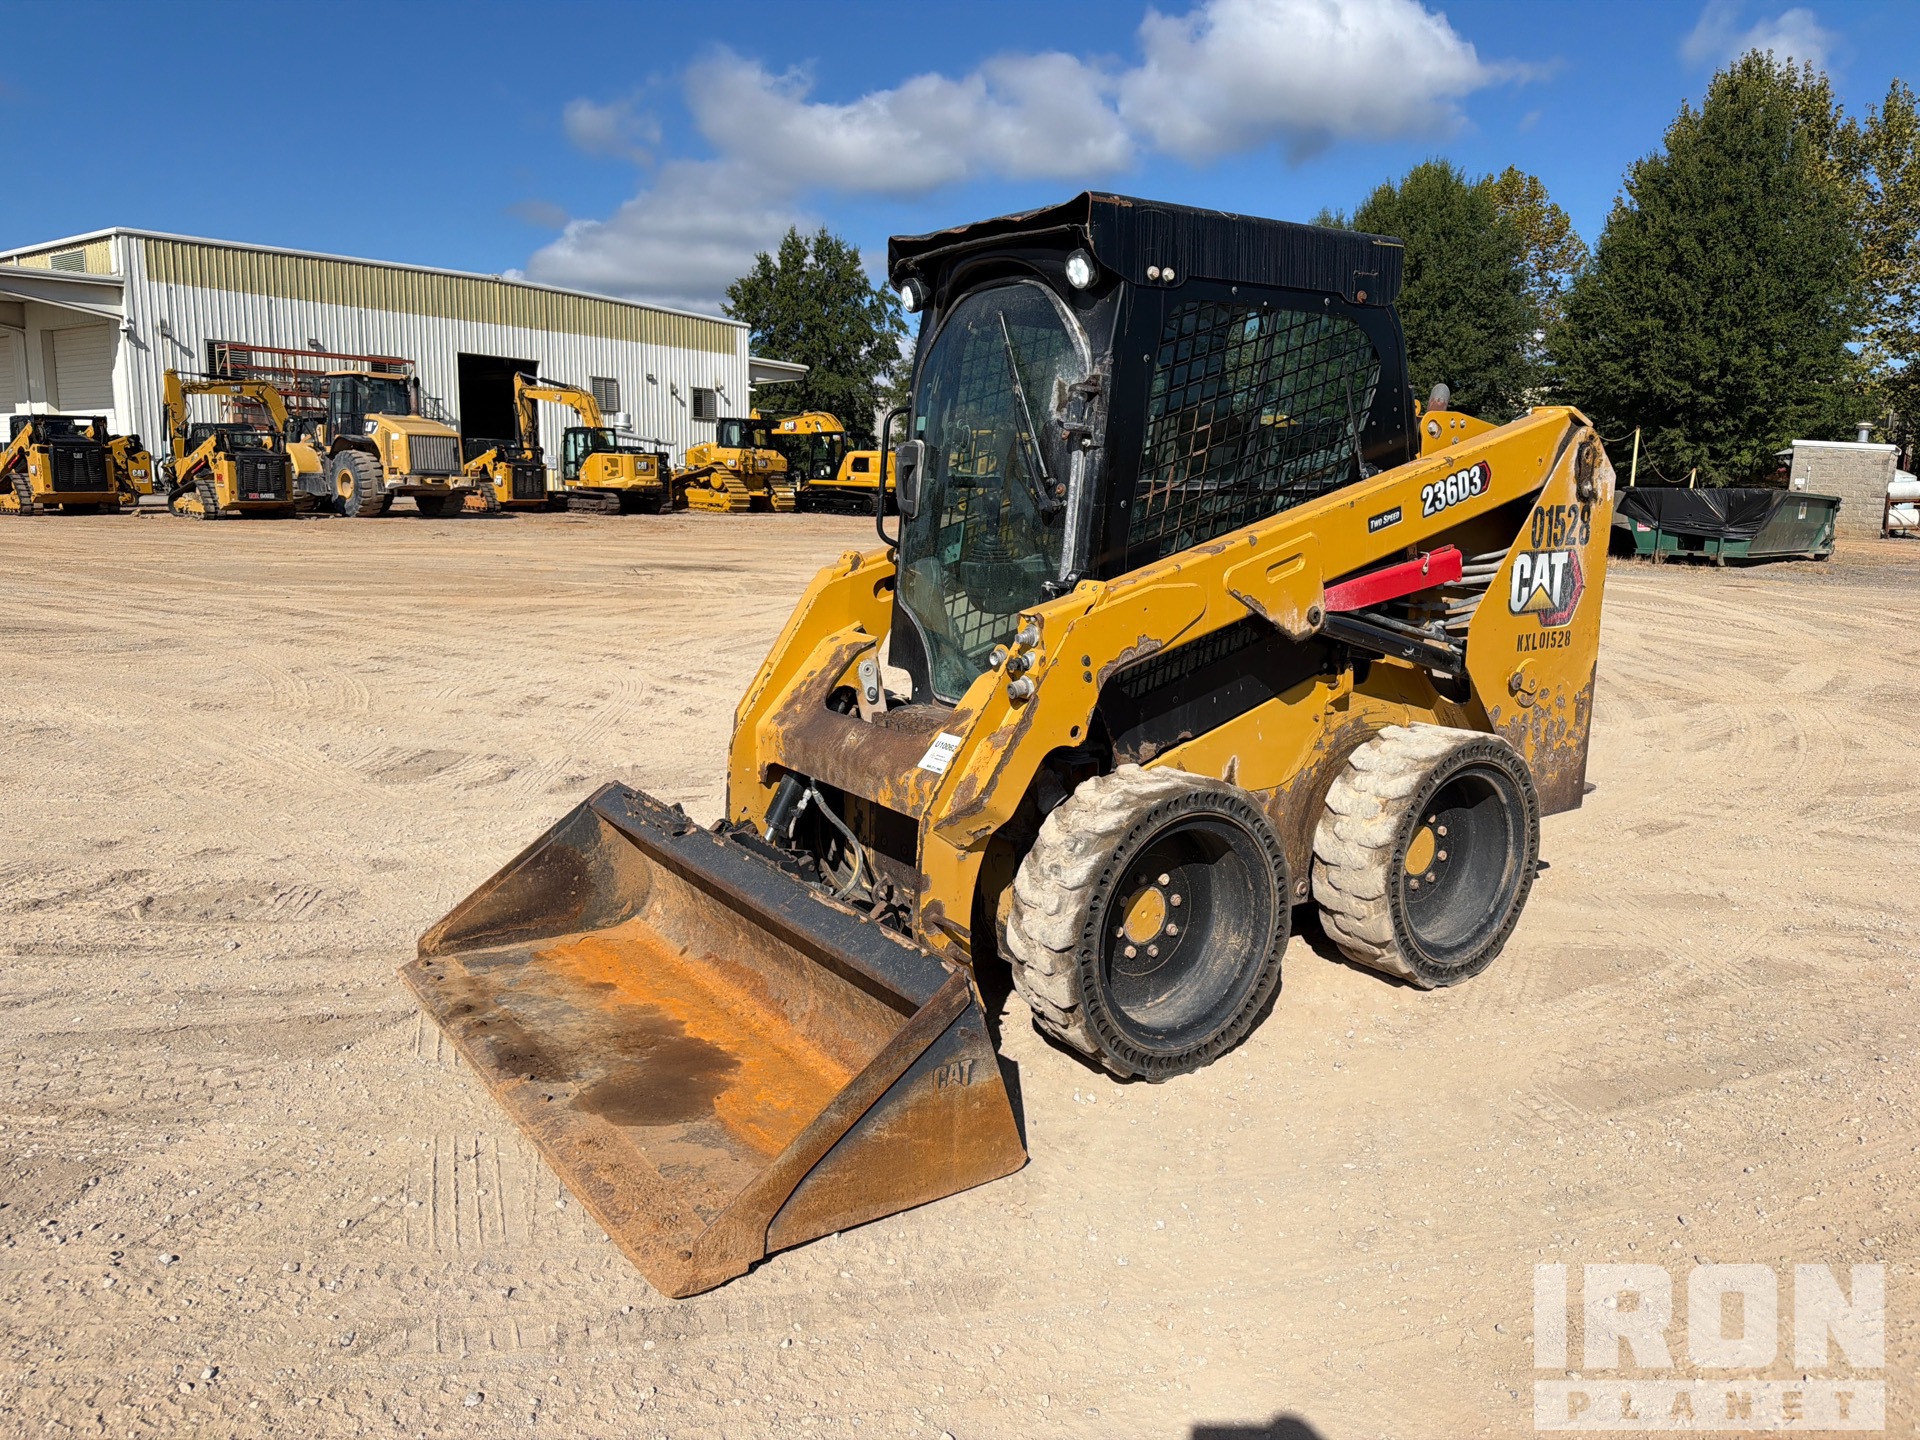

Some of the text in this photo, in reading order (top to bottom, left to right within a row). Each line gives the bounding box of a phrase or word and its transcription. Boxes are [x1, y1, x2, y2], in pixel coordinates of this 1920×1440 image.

[784, 422, 796, 432] CAT
[132, 469, 146, 477] CAT
[637, 461, 648, 470] CAT
[1422, 465, 1483, 516] 236D3
[1531, 503, 1591, 548] 01528
[1510, 552, 1569, 613] CAT
[1516, 630, 1572, 653] KXL01528
[933, 1059, 974, 1095] CAT
